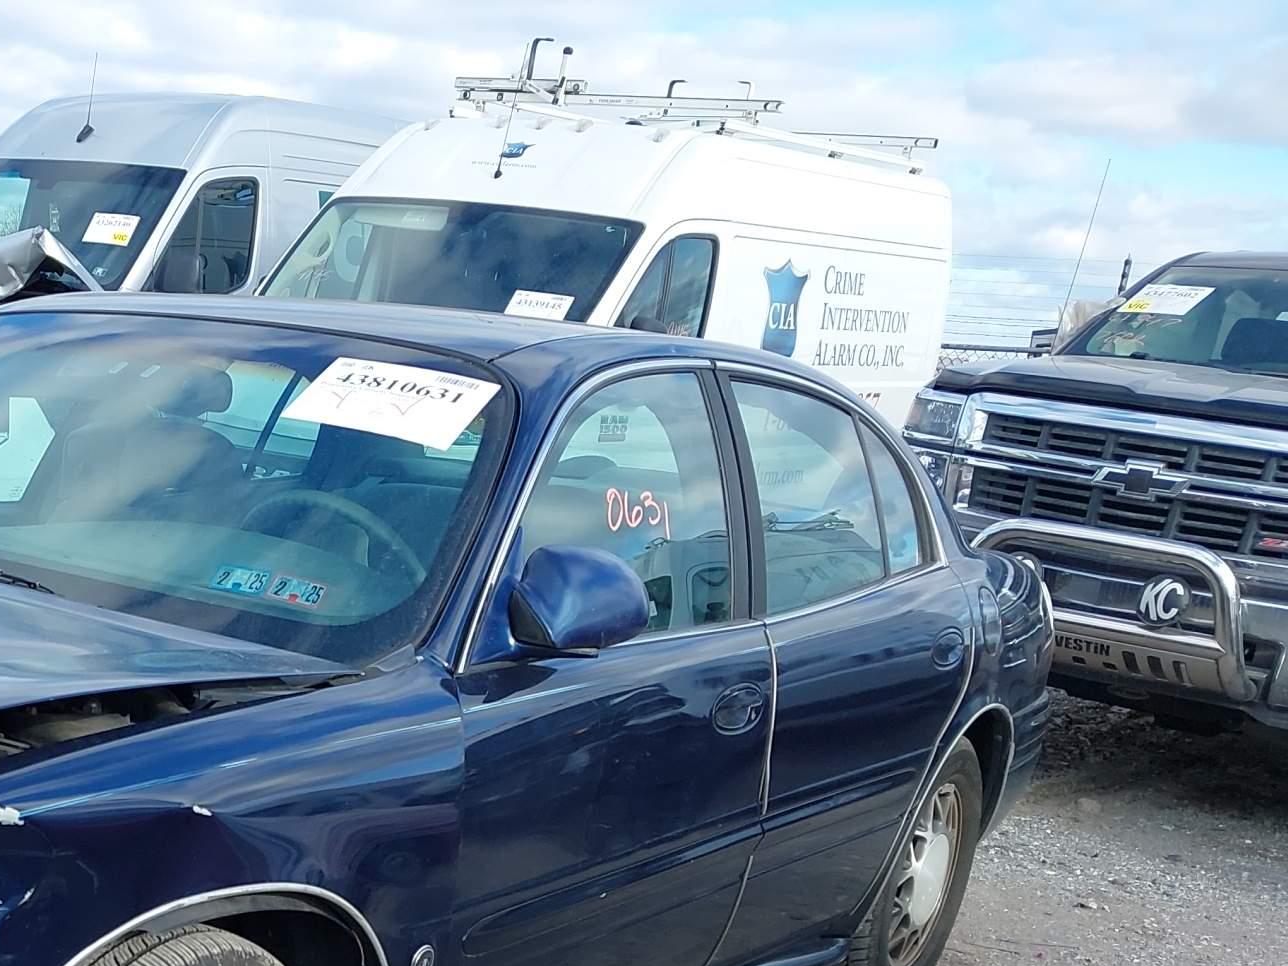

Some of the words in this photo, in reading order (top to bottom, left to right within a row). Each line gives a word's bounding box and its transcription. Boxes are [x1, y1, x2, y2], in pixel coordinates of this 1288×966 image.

[505, 147, 524, 155] CIA
[113, 233, 128, 242] VIC
[769, 302, 796, 330] CIA
[1127, 302, 1150, 310] VIC
[335, 372, 464, 404] 43810631
[606, 487, 671, 541] 0631
[216, 571, 231, 586] 2
[248, 573, 268, 591] 25
[273, 580, 288, 597] 2
[304, 585, 325, 604] 25
[1139, 578, 1185, 621] KC
